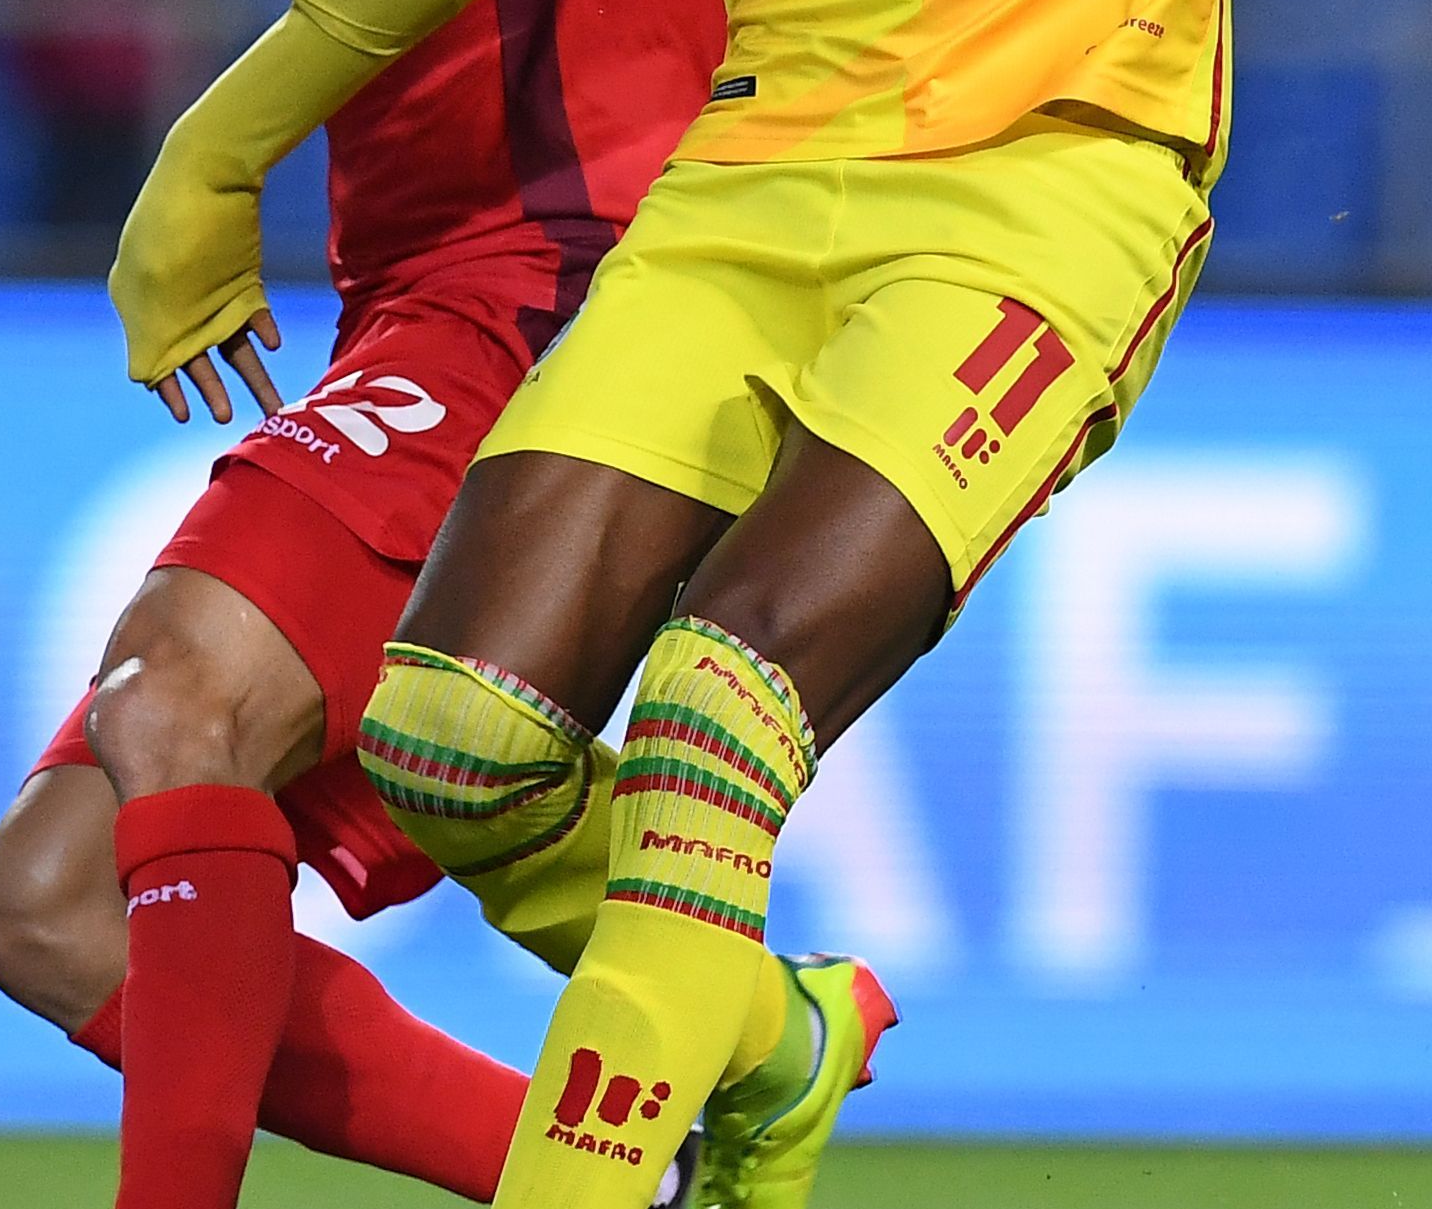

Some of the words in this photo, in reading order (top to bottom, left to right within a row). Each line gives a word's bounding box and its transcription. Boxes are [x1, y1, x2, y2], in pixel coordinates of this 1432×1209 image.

[953, 296, 1075, 437] 11
[932, 444, 968, 490] MAFRO
[694, 656, 806, 788] MAFRO
[640, 830, 771, 878] MAFRO
[545, 1124, 643, 1166] MAFRO
